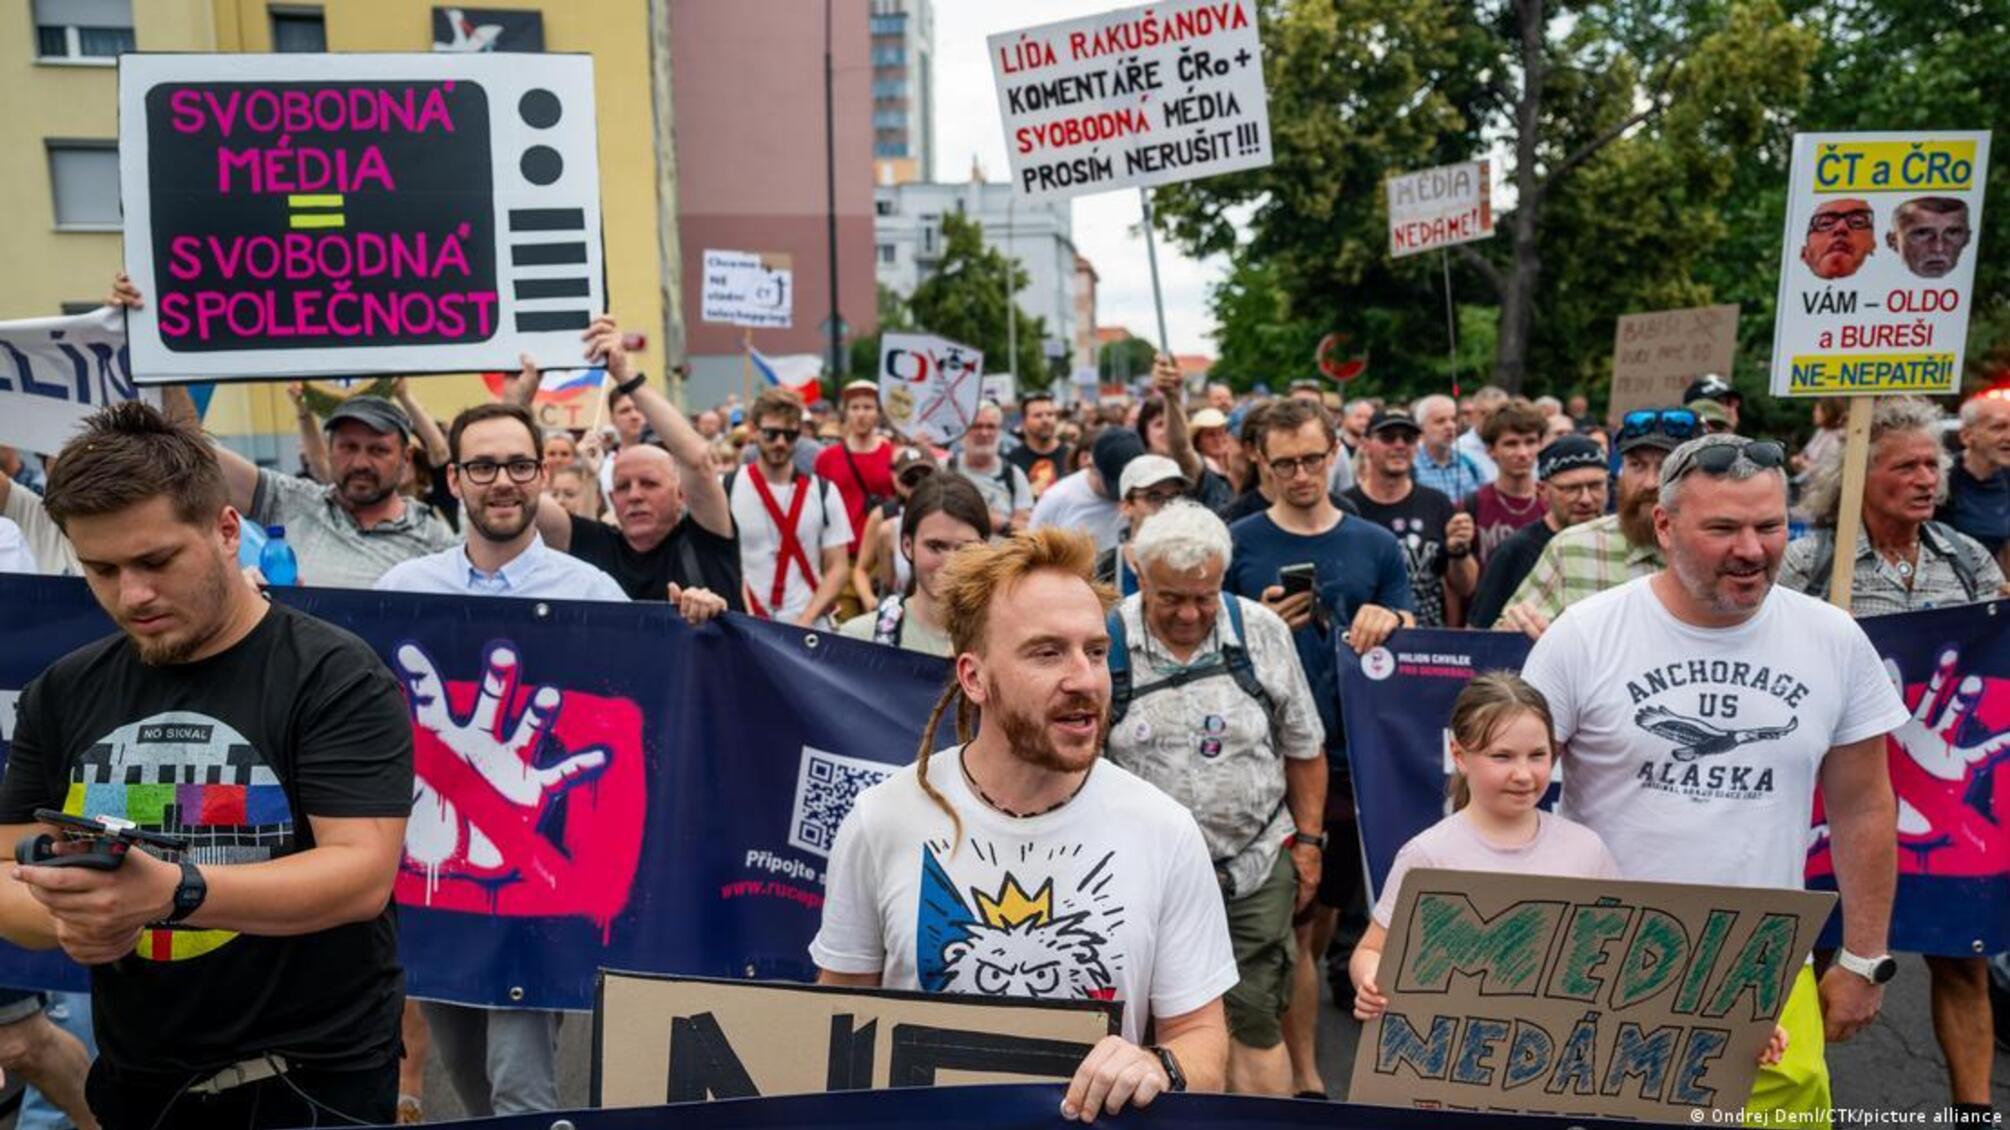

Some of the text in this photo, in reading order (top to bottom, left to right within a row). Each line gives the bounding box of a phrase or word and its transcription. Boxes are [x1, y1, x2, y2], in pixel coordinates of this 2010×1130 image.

[1000, 2, 1248, 74] LÍDA RAKUŠANOVA
[170, 80, 455, 138] SVOBODNÁ
[1008, 56, 1162, 115] KOMENTÁŘE
[1016, 85, 1240, 154] SVOBODNÁ MÉDIA
[217, 133, 395, 193] MÉDIA
[1022, 147, 1113, 193] PROSÍM
[1817, 143, 1972, 186] ČT a ČRo
[168, 222, 471, 279] SVOBODNÁ
[159, 279, 498, 340] SPOLEČNOST
[1803, 285, 1857, 315] VÁM
[1887, 288, 1959, 314] OLDO
[1819, 318, 1933, 348] a BUREŠI
[1626, 660, 1810, 709] ANCHORAGE
[1699, 693, 1738, 718] US
[144, 728, 162, 739] NO
[1637, 761, 1774, 791] ALASKA
[745, 849, 816, 880] Připojte
[1394, 892, 1800, 1022] MÉDIA
[1374, 1012, 1731, 1108] NEDÁME
